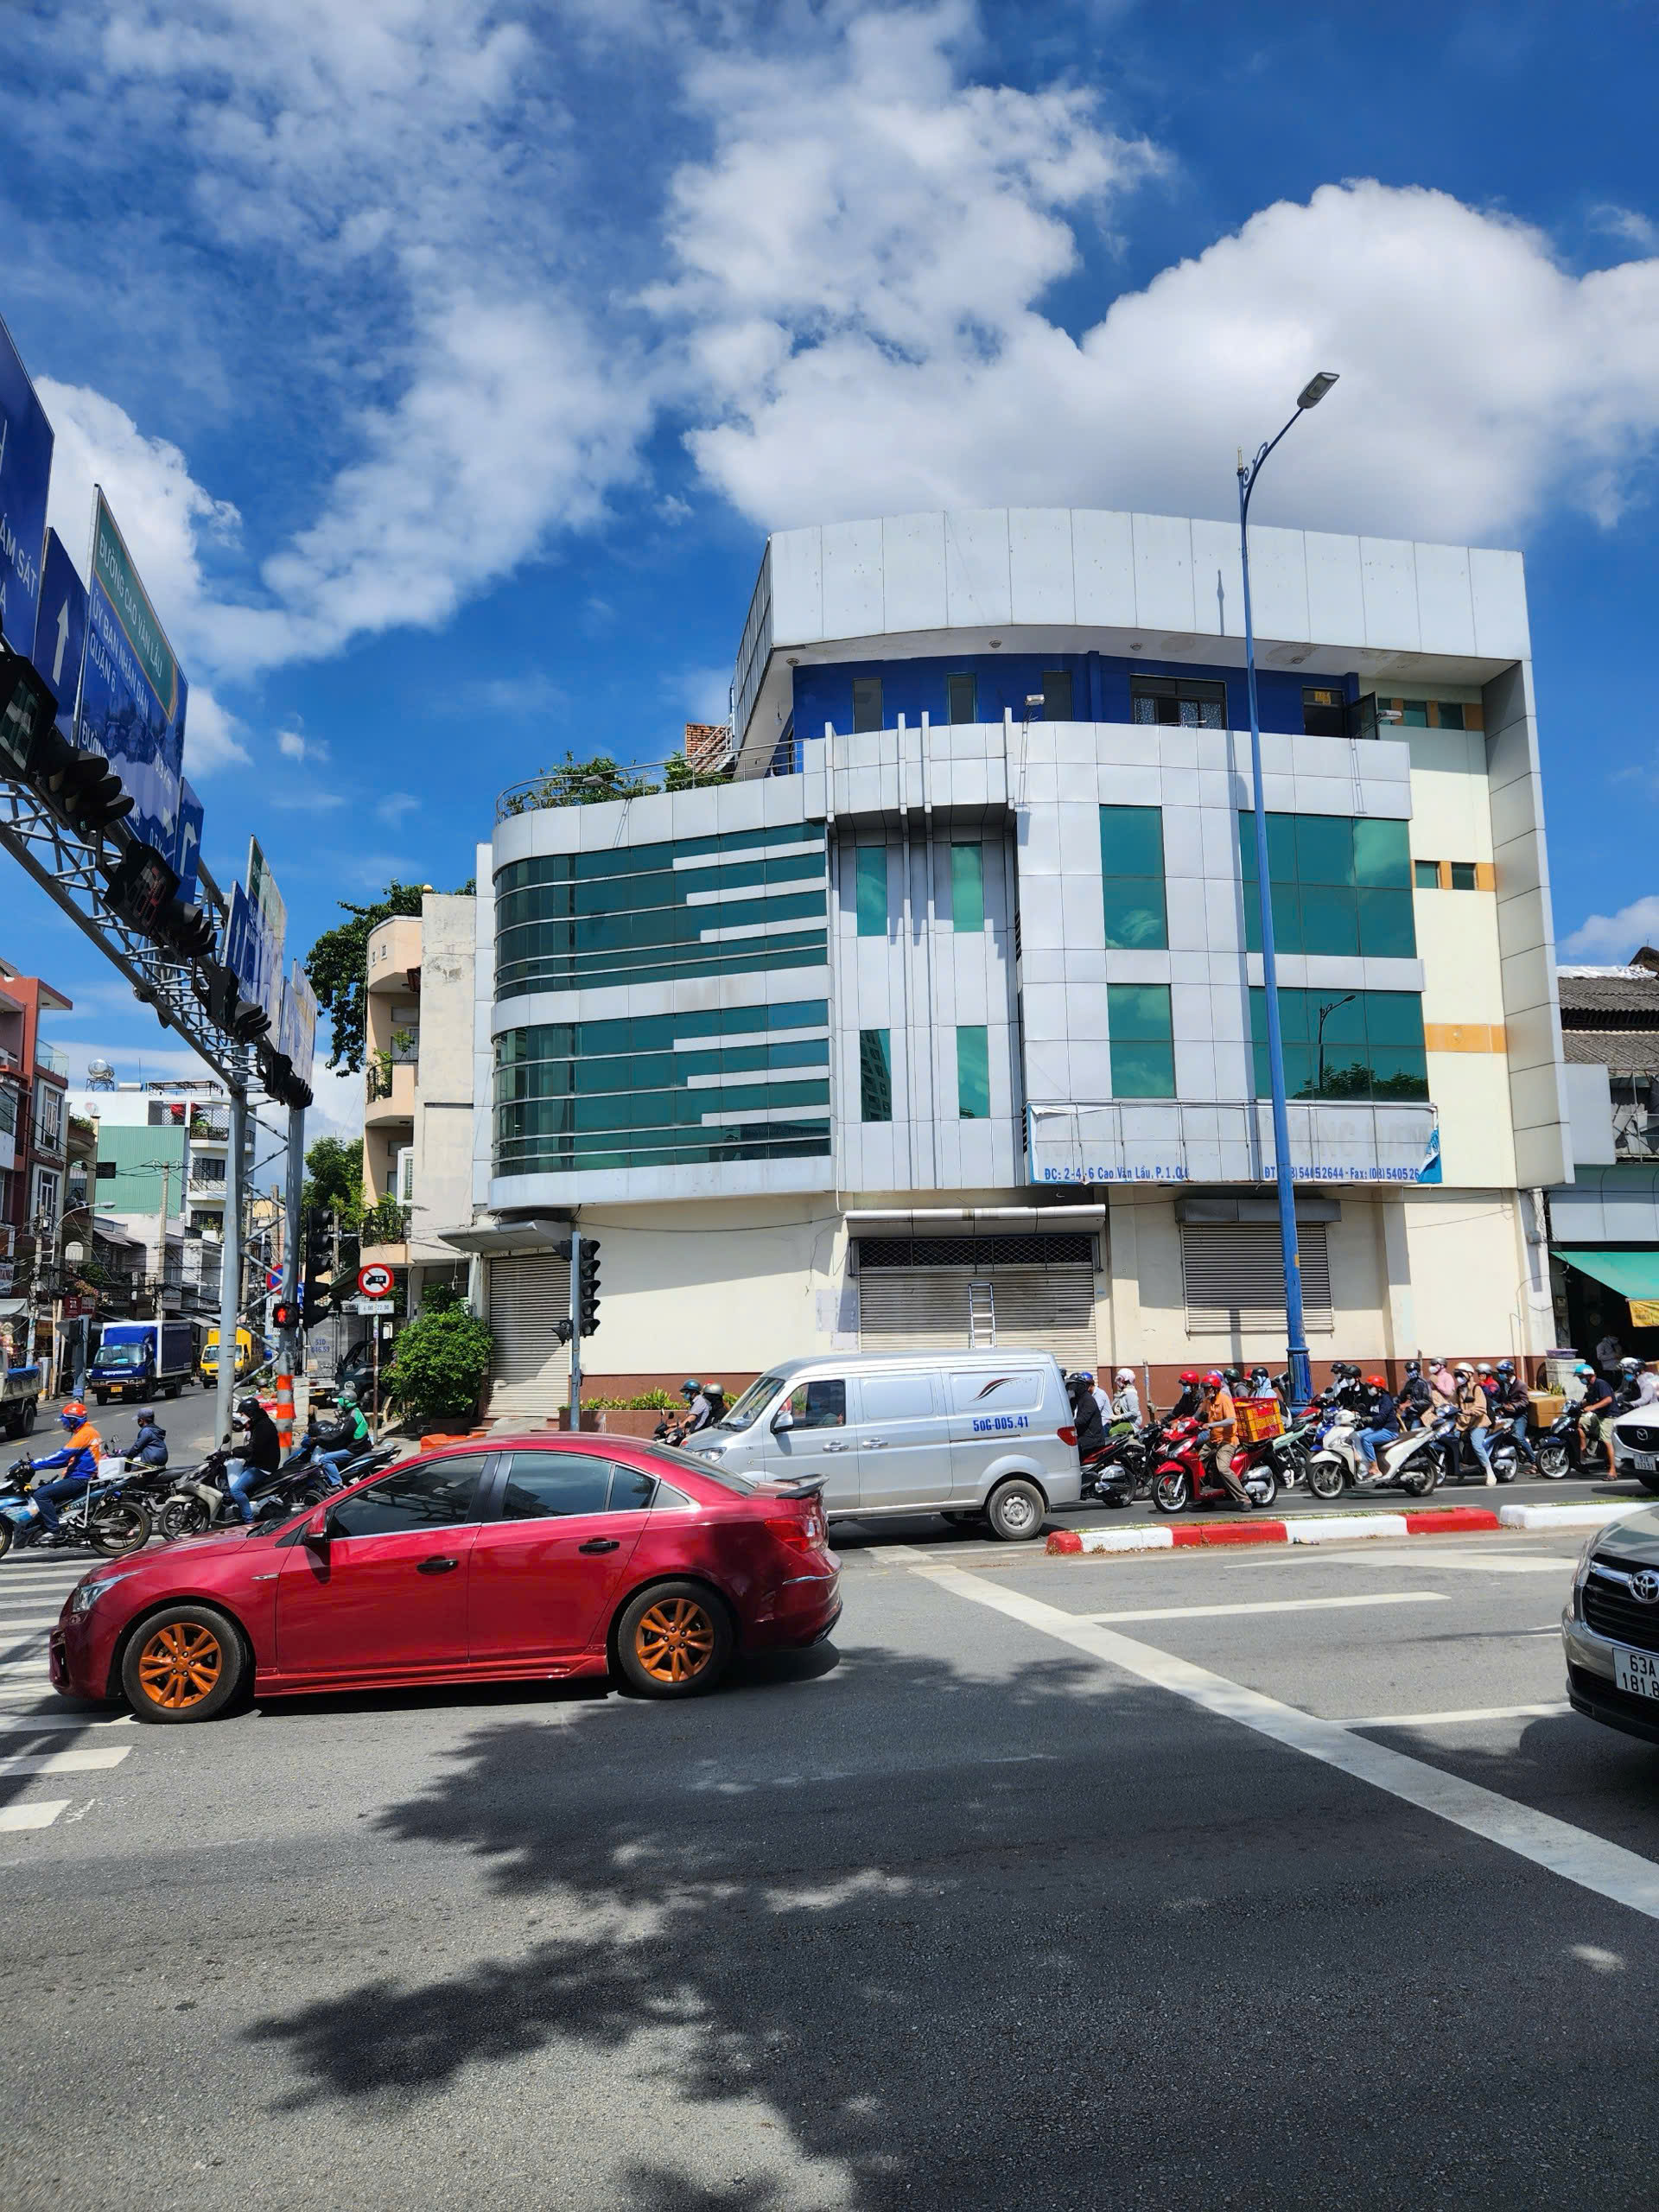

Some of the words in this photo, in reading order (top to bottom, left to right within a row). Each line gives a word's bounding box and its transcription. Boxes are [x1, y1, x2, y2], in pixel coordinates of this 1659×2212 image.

[17, 549, 37, 598] SÁT
[99, 532, 124, 597] ĐƯỜNG
[124, 588, 137, 625] CAO
[90, 632, 111, 684] QUẬN
[111, 671, 117, 692] 6
[103, 615, 119, 658] BAN
[119, 645, 137, 695] NHÂN
[1045, 1167, 1061, 1180] ĐC:
[1097, 1166, 1114, 1179] Cao
[1351, 1167, 1368, 1180] Fax:
[973, 1416, 1028, 1432] 50G-005.41
[1630, 1654, 1656, 1678] 63A
